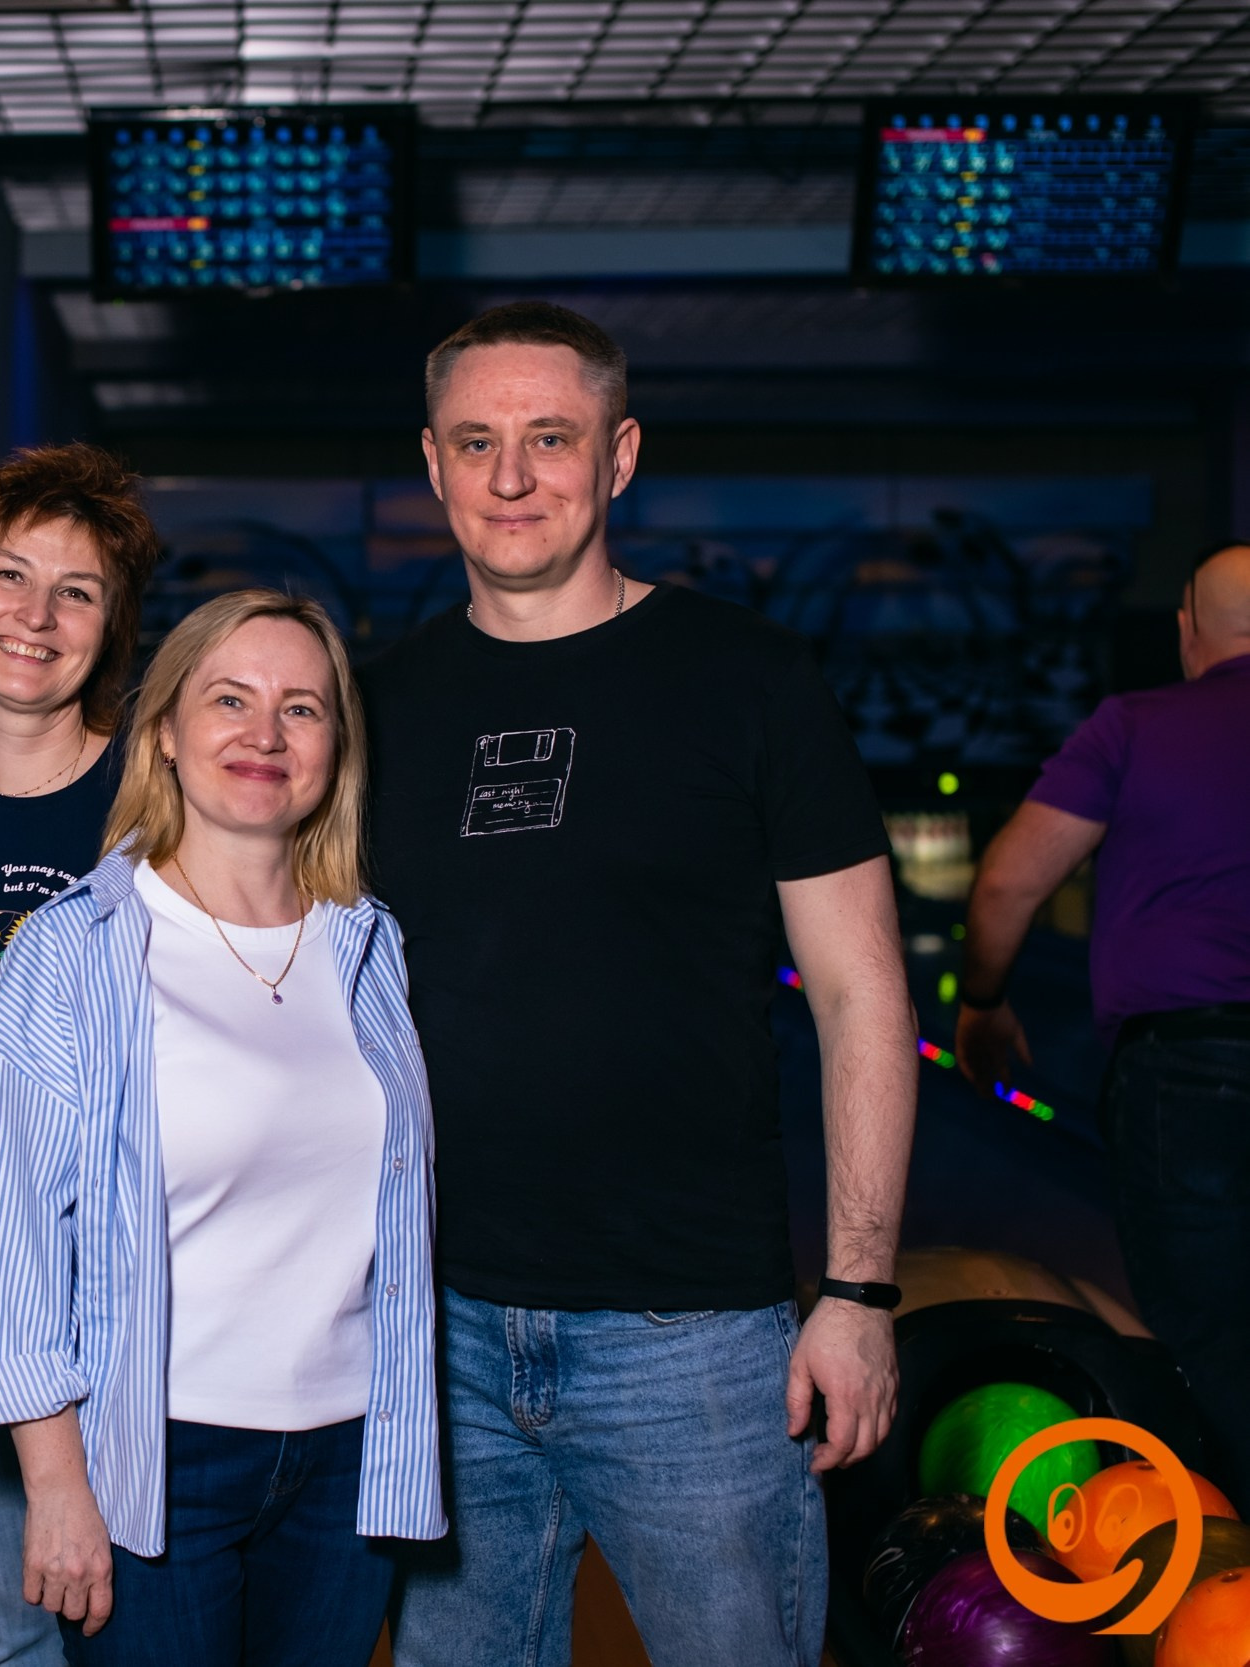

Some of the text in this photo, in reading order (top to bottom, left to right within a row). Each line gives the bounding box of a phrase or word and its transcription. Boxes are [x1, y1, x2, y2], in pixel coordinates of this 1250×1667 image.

[501, 785, 525, 802] night
[1, 864, 78, 885] You may say
[3, 881, 24, 893] but
[26, 882, 50, 895] I'm
